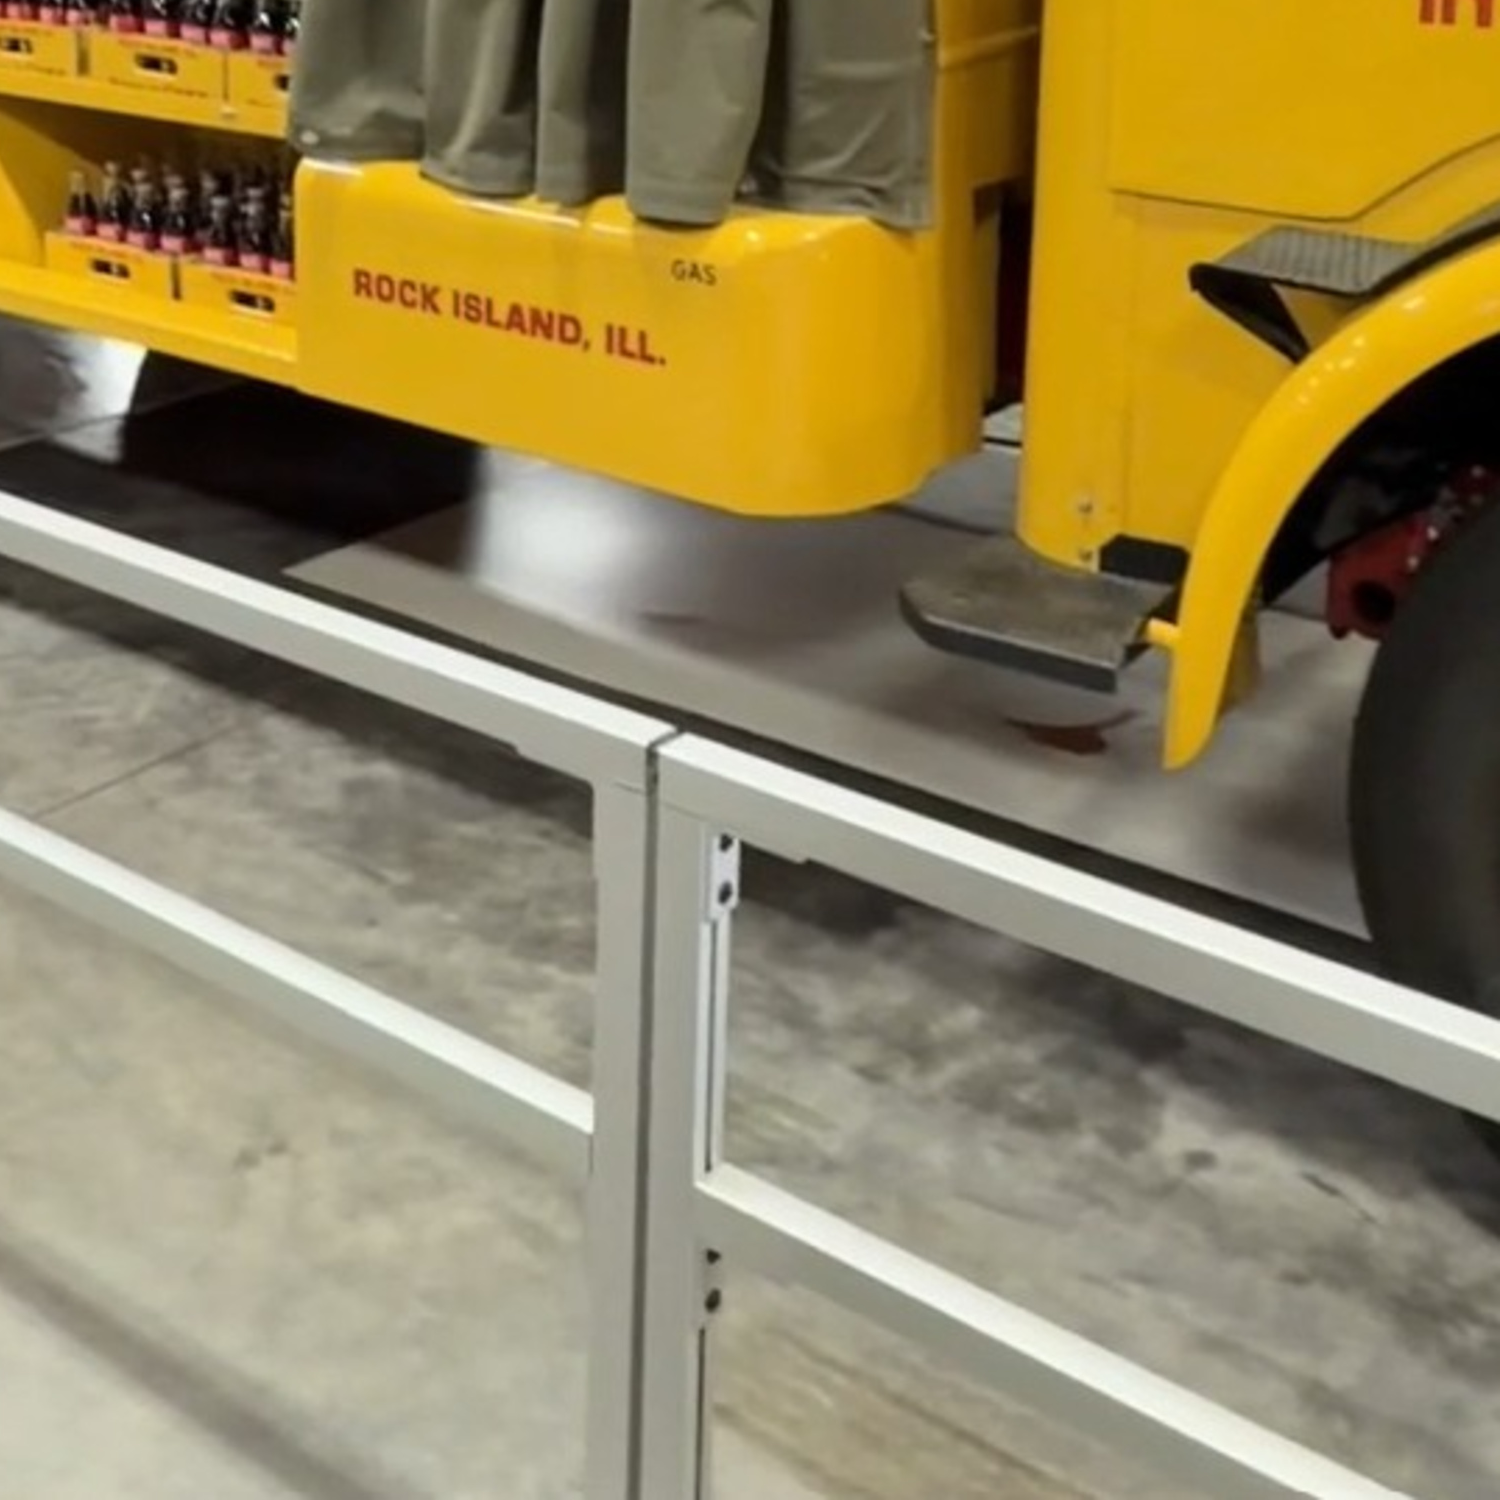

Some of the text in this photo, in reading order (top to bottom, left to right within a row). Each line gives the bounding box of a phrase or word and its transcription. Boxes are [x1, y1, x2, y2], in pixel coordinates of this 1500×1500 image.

[670, 260, 718, 286] GAS
[352, 268, 441, 315] ROCK
[452, 290, 591, 352] ISLAND,
[605, 323, 667, 366] ILL.
